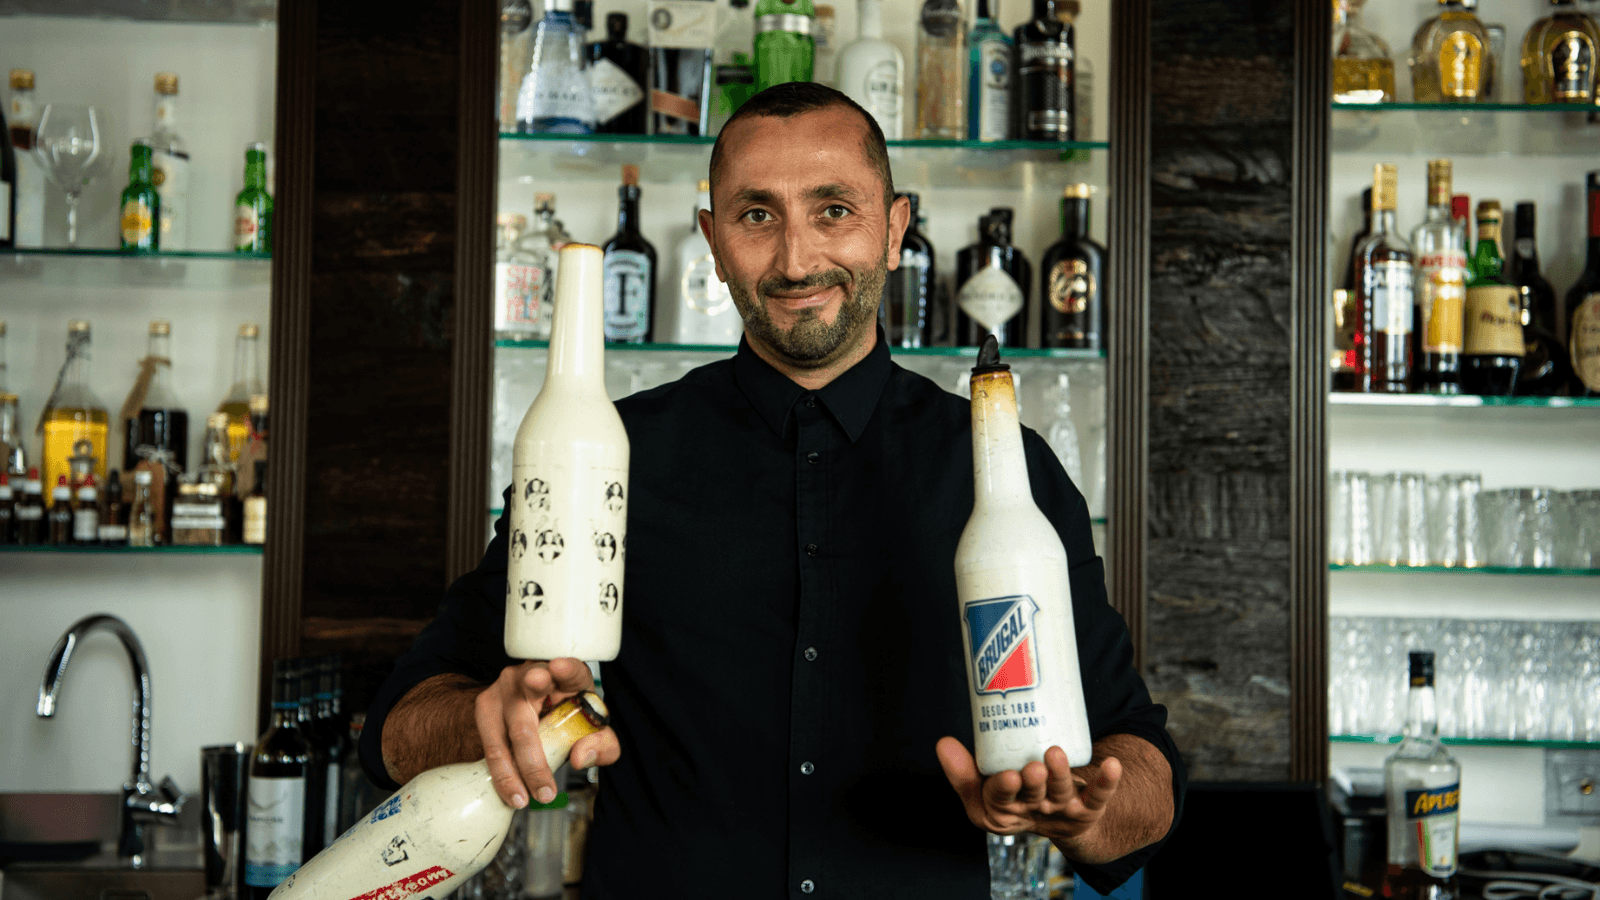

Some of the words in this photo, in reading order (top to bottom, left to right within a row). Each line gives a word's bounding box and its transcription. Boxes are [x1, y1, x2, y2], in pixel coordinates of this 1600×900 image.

[978, 604, 1027, 688] BRUGAL
[981, 703, 1007, 718] DESDE
[1011, 701, 1036, 715] 1888
